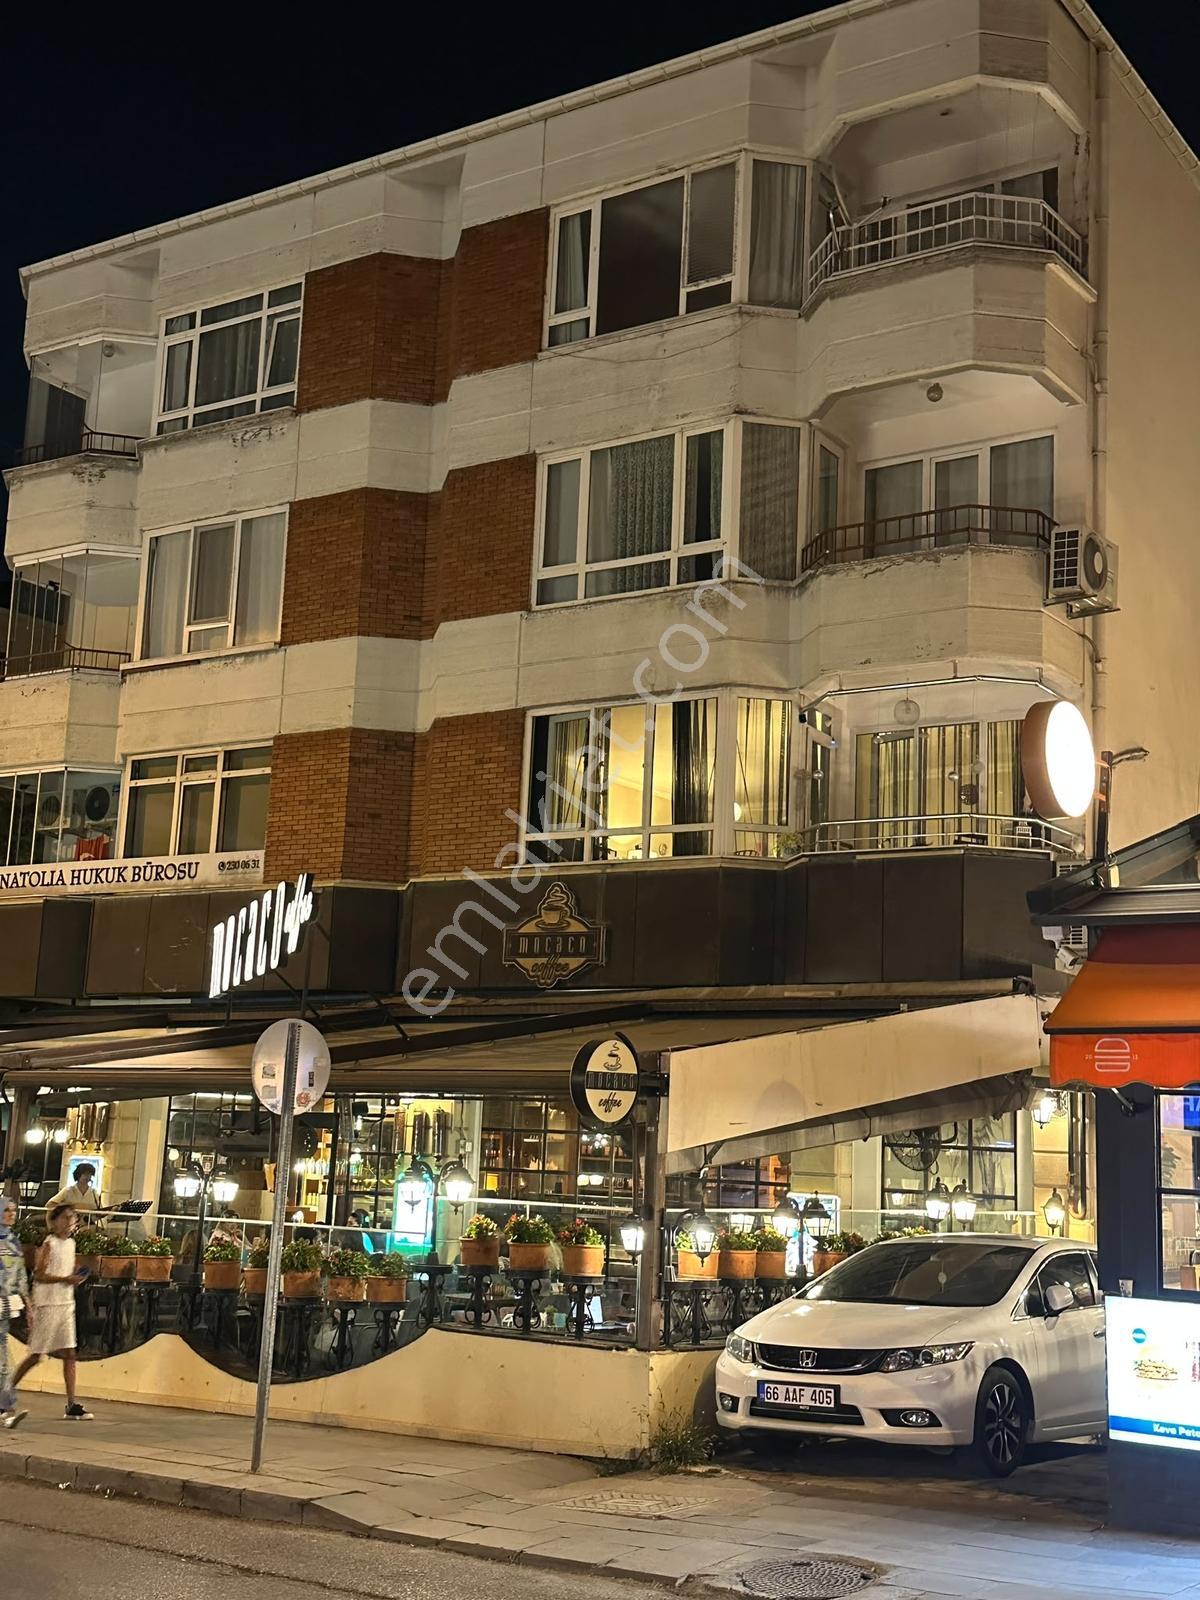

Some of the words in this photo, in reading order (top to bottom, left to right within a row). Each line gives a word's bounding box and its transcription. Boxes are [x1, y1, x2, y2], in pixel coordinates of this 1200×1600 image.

[0, 869, 66, 889] NATOLIA
[70, 863, 128, 885] HUKUK
[131, 862, 200, 882] BÜROSU
[598, 1092, 623, 1113] coffee
[765, 1386, 779, 1401] 66
[784, 1387, 805, 1403] AAF
[811, 1389, 832, 1406] 405
